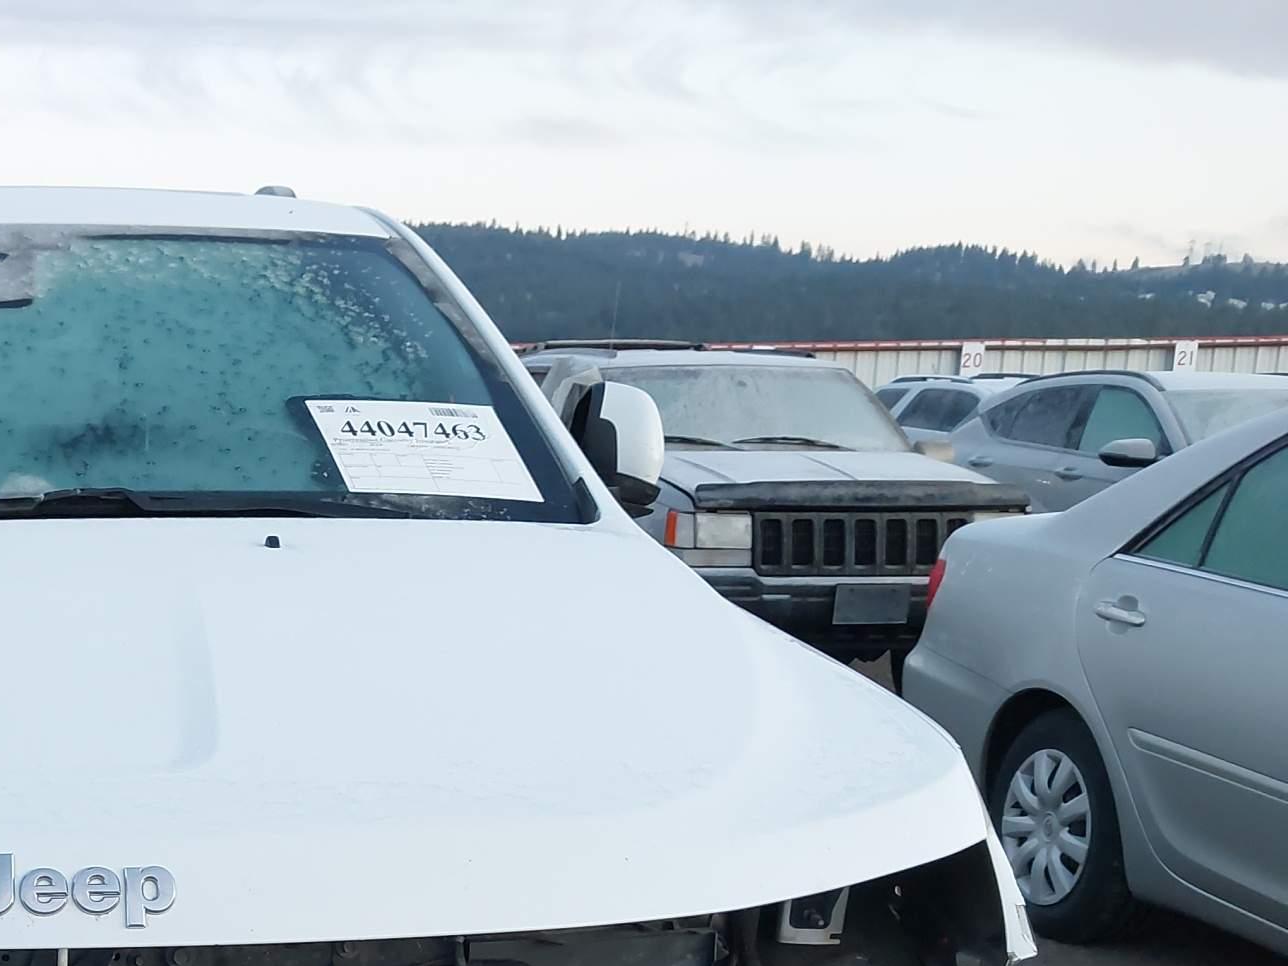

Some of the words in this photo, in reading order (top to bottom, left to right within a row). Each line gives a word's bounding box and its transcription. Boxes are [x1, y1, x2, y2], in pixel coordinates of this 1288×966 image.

[961, 352, 983, 368] 20
[1176, 350, 1195, 366] 21
[341, 420, 486, 441] 44047463
